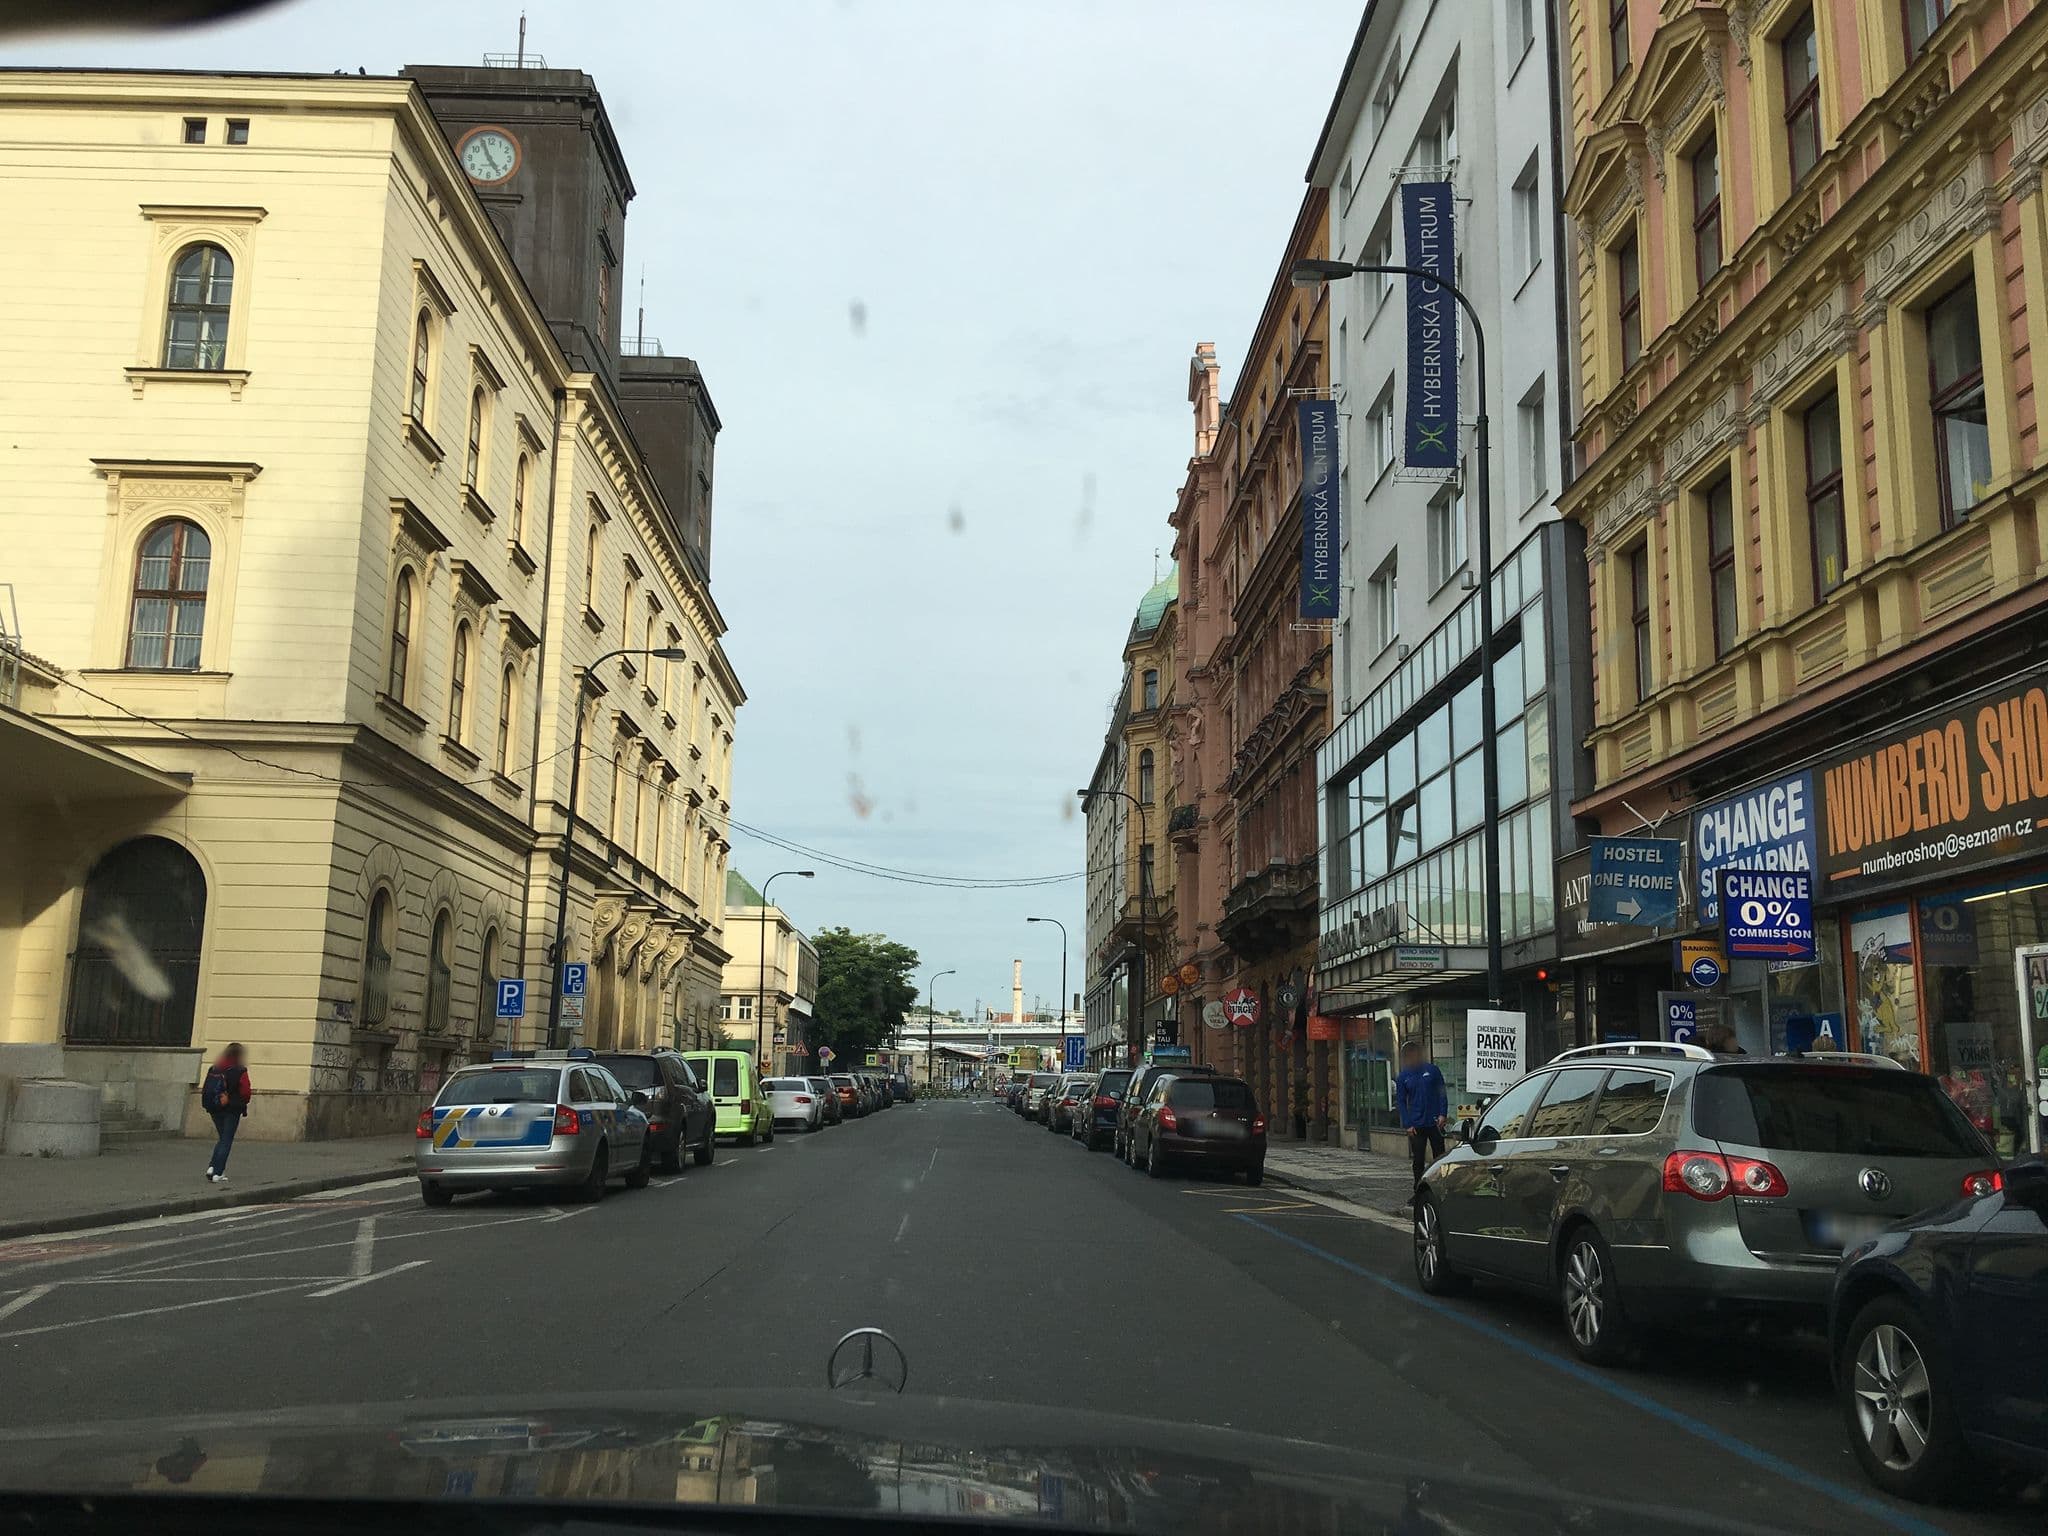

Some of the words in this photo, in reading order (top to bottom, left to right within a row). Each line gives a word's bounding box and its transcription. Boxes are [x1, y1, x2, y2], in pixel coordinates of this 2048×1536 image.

[1418, 300, 1441, 417] HYBERNSKÁ
[1311, 489, 1328, 580] HYBERNSKÁ
[1824, 719, 1970, 857] NUMBERO
[1699, 779, 1806, 862] CHANGE
[1603, 847, 1664, 863] HOSTEL
[1862, 818, 2033, 876] numberoshop@seznam.cz
[1594, 872, 1624, 886] ONE
[1628, 874, 1673, 890] HOME
[1726, 875, 1809, 899] CHANGE
[1740, 901, 1801, 927] 0%
[1729, 928, 1812, 939] COMMISSION
[568, 967, 582, 986] P
[502, 984, 519, 1006] P
[1227, 1005, 1257, 1014] BURGER
[1669, 1004, 1693, 1019] 0%
[1820, 1019, 1832, 1038] A
[1477, 1033, 1517, 1052] PARKY,
[1477, 1058, 1517, 1071] PUSTINU?
